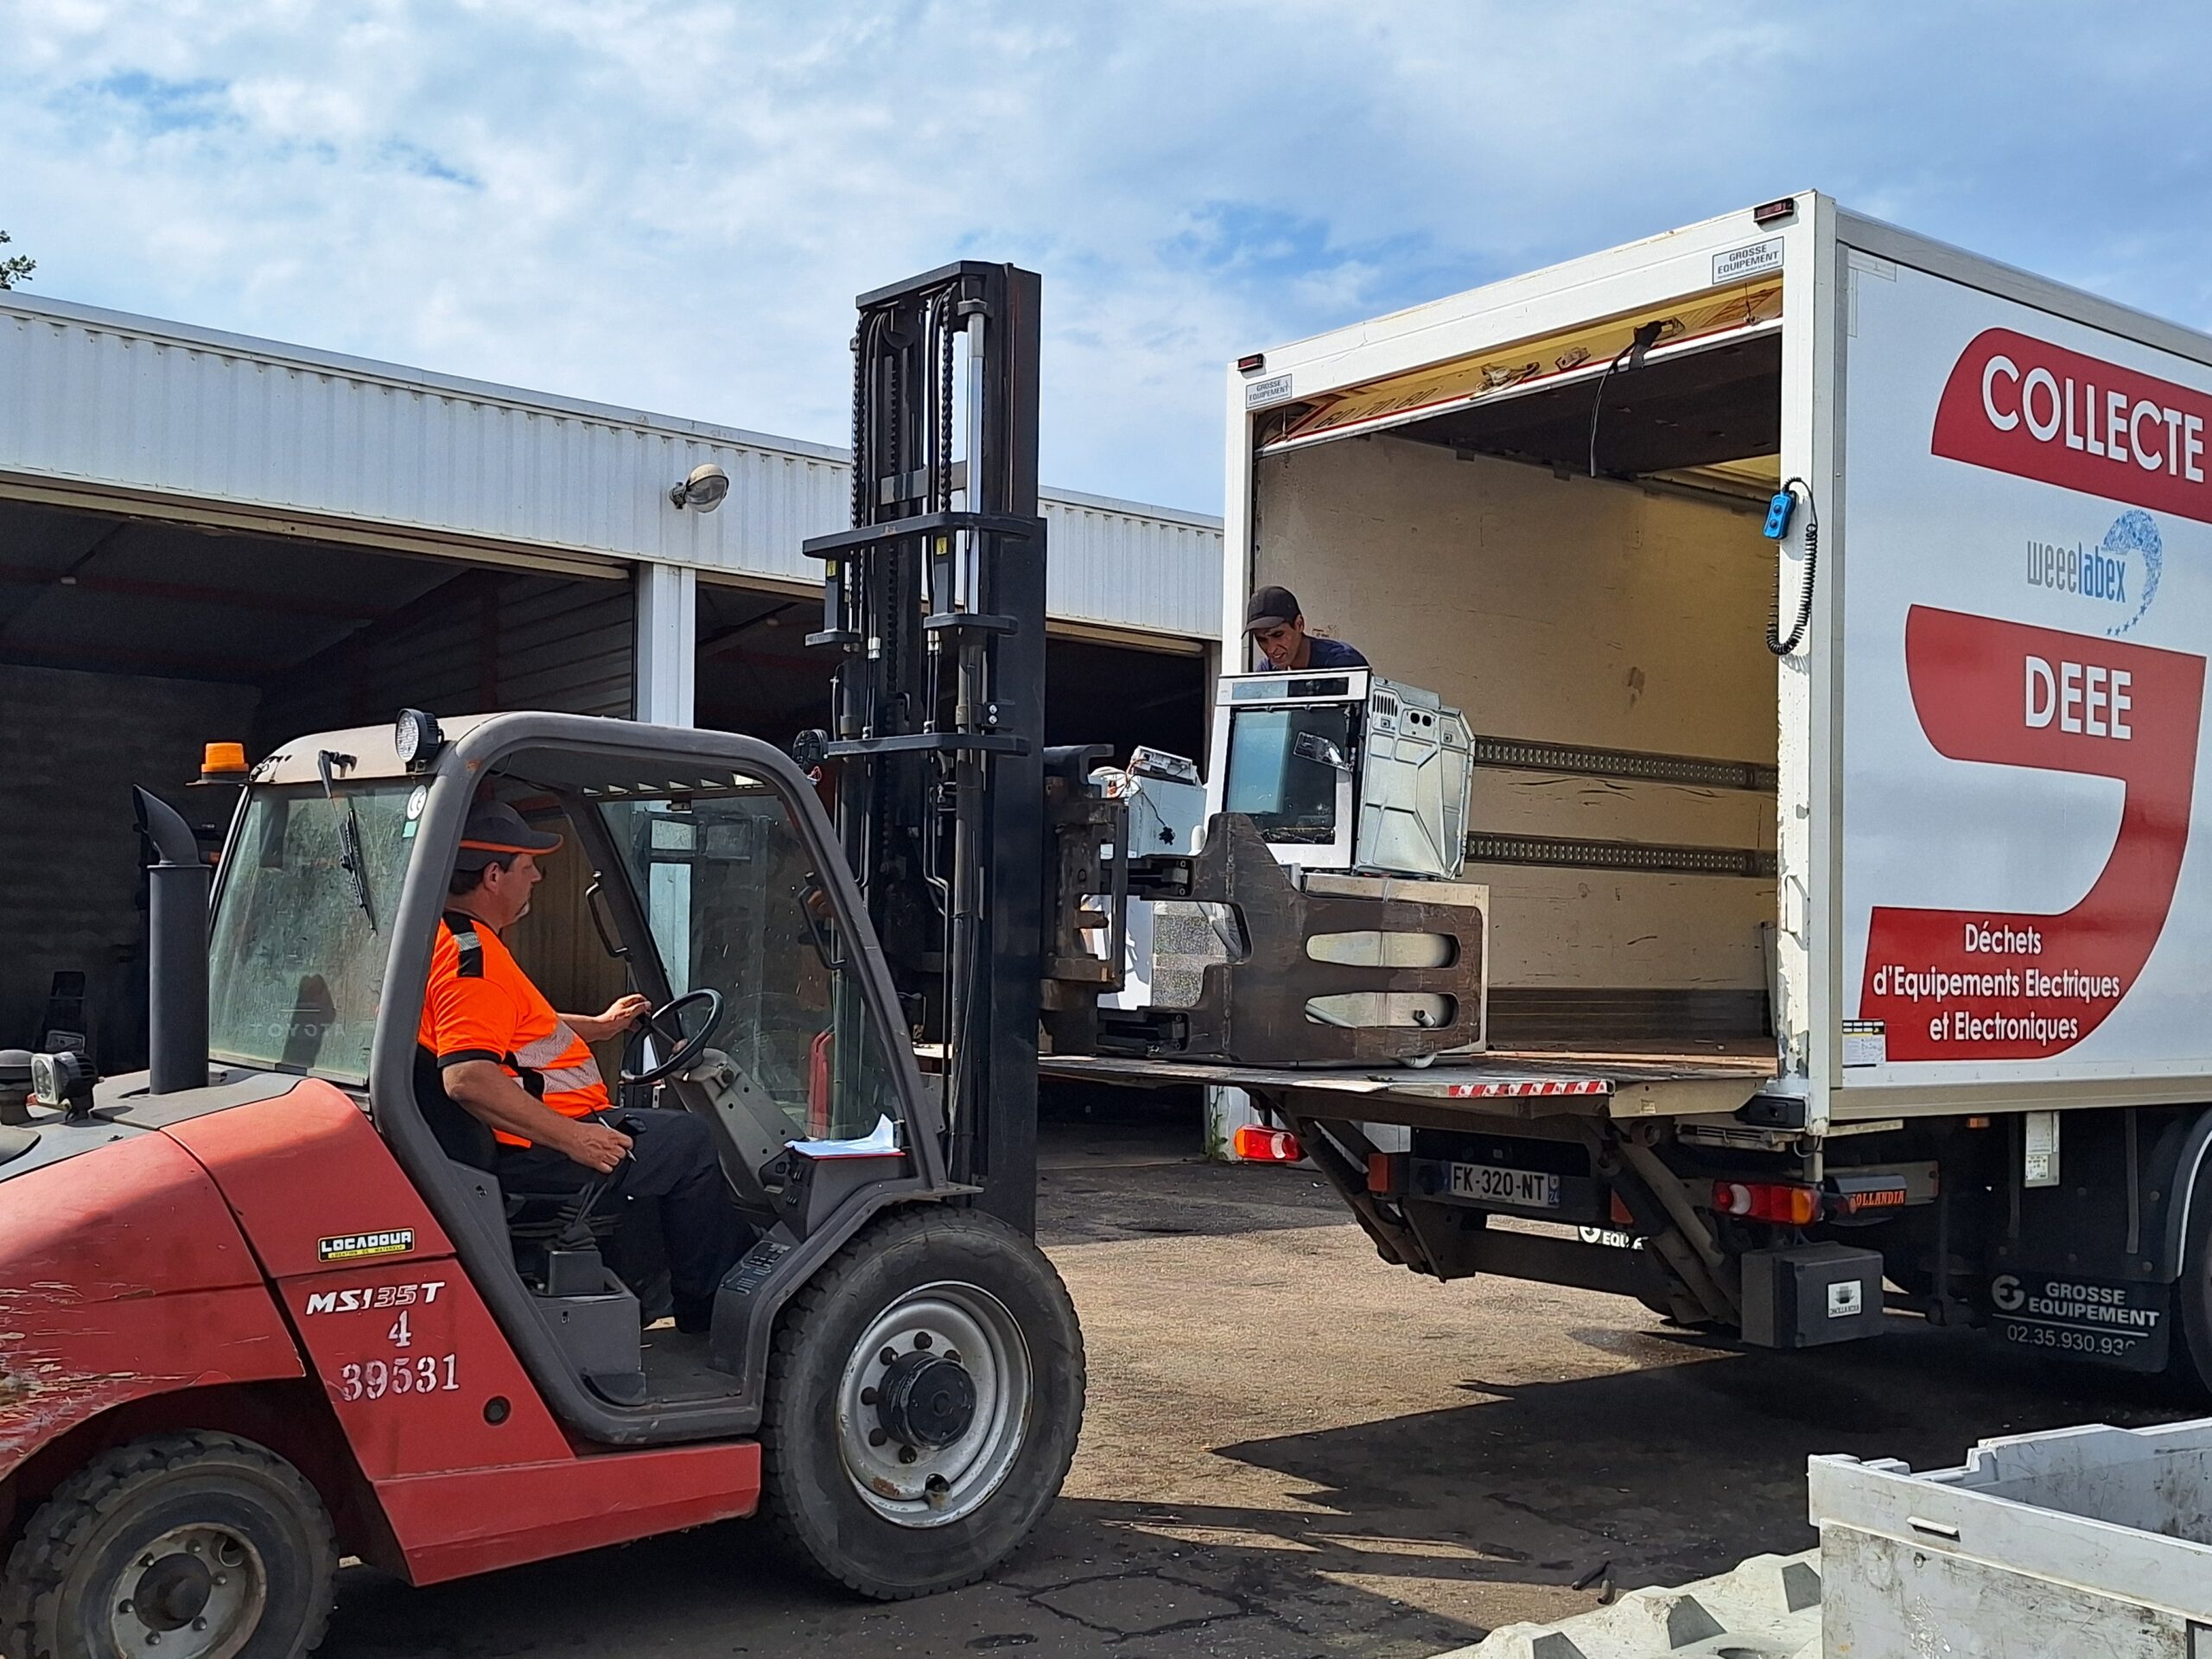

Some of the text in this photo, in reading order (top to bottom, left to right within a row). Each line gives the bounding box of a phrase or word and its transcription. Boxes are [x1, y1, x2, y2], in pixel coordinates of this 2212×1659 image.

[1718, 251, 1779, 274] EQUIPEMENT
[1729, 245, 1767, 262] GROSSE
[1981, 354, 2204, 483] COLLECTE
[2026, 541, 2126, 604] weeelabex
[2024, 655, 2133, 741] DEEE
[1965, 921, 2042, 955] Déchets
[1873, 965, 2121, 1003] d'Equipements Electriques
[1929, 1011, 2079, 1046] et Electroniques
[1453, 1166, 1544, 1200] FK-320-NT
[2045, 1281, 2126, 1305] GROSSE
[388, 1309, 412, 1348] 4
[2028, 1297, 2160, 1327] EQUIPEMENT
[341, 1353, 460, 1402] 39531
